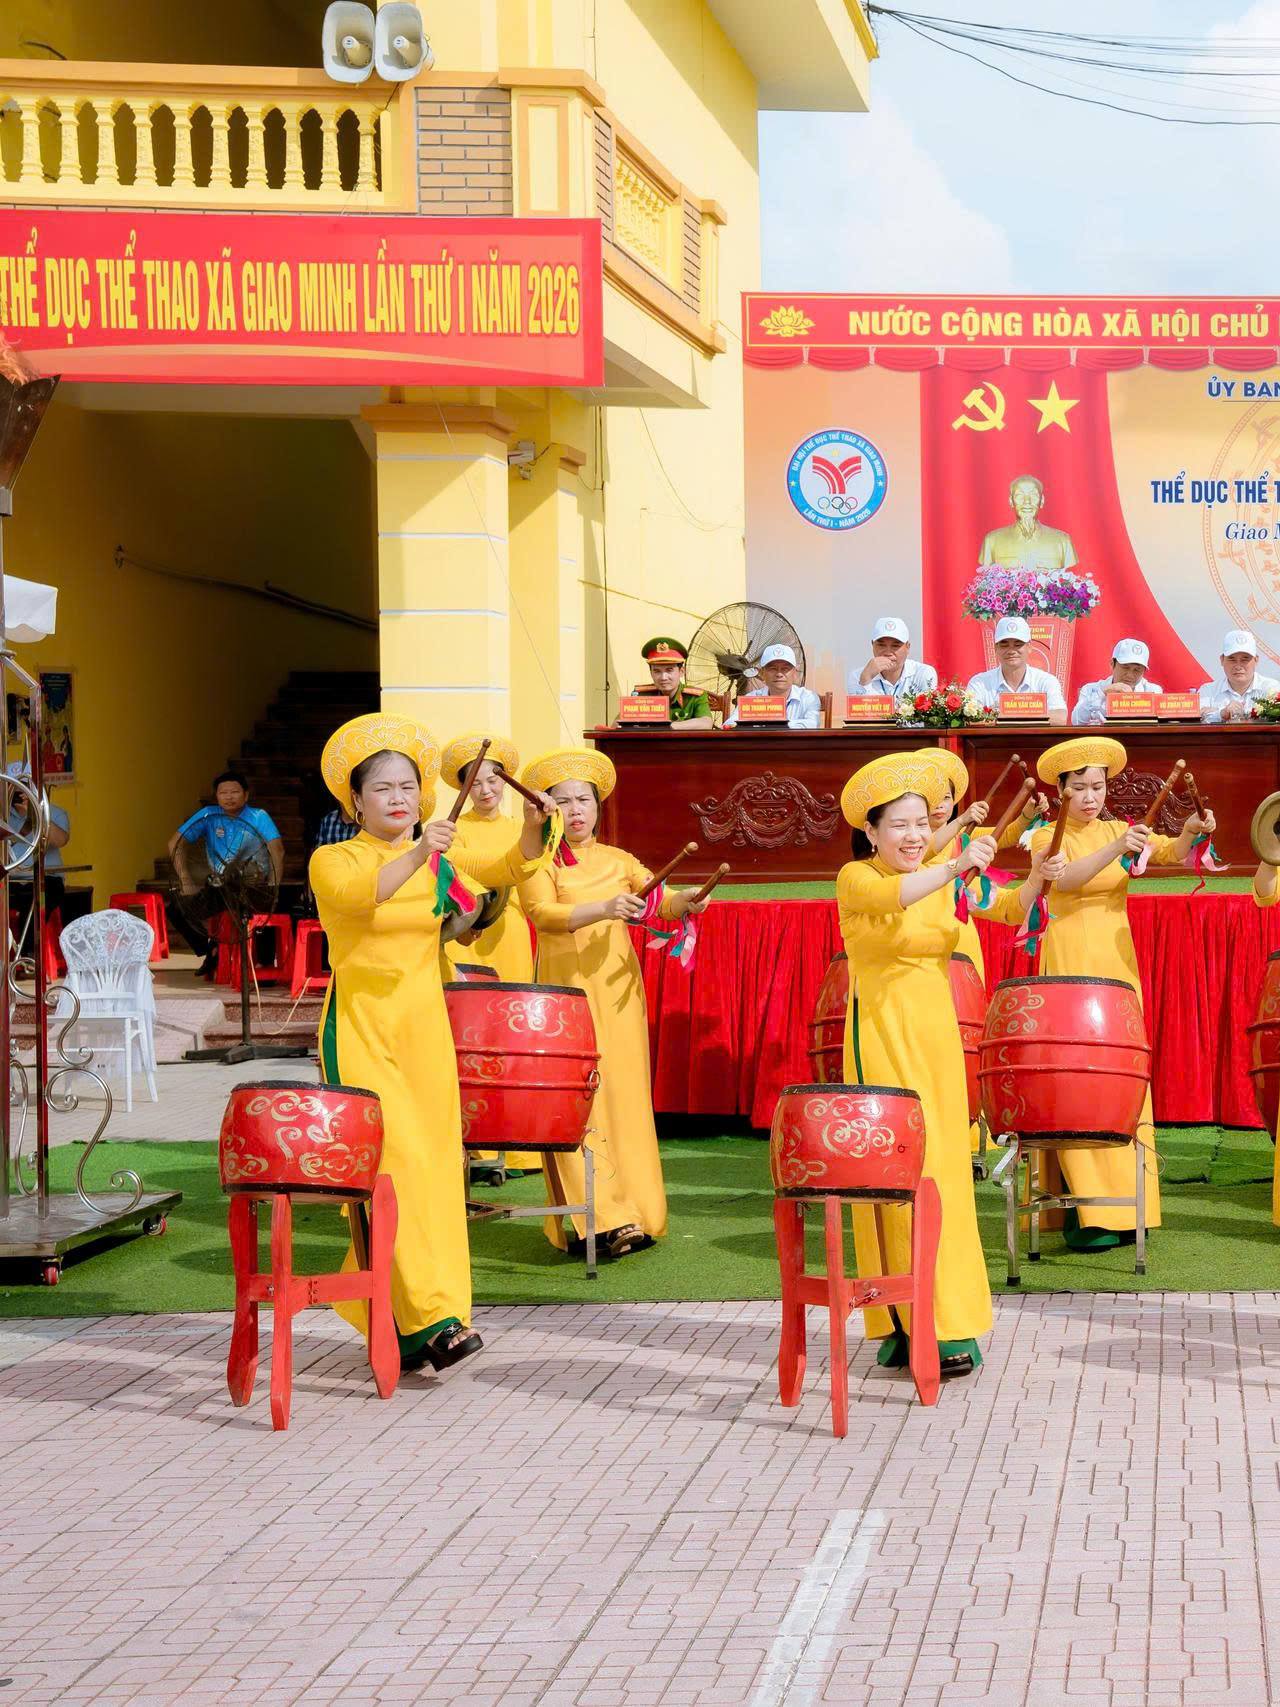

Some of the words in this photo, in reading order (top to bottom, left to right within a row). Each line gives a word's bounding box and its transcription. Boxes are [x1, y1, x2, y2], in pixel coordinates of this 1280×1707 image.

[0, 227, 40, 327] THỂ
[44, 257, 91, 345] DỤC
[95, 229, 138, 329] THỂ
[142, 260, 200, 332] THAO
[205, 247, 237, 331] XÃ
[241, 260, 293, 333] GIAO
[298, 262, 358, 333] MINH
[362, 239, 406, 333] LẦN
[410, 248, 454, 334] THỨ
[457, 264, 466, 334] I
[471, 250, 522, 334] NĂM
[527, 265, 580, 335] 2026
[848, 304, 931, 337] NƯỚC
[941, 306, 1023, 342] CỘNG
[1032, 308, 1093, 337] HÒA
[1102, 308, 1142, 337] XÃ
[1151, 309, 1200, 341] HỘI
[1210, 304, 1269, 337] CHỦ
[1208, 374, 1235, 397] ỦY
[1150, 471, 1186, 504] THỂ
[1191, 480, 1228, 508] DỤC
[1234, 471, 1269, 504] THỂ
[1225, 523, 1268, 541] Giao
